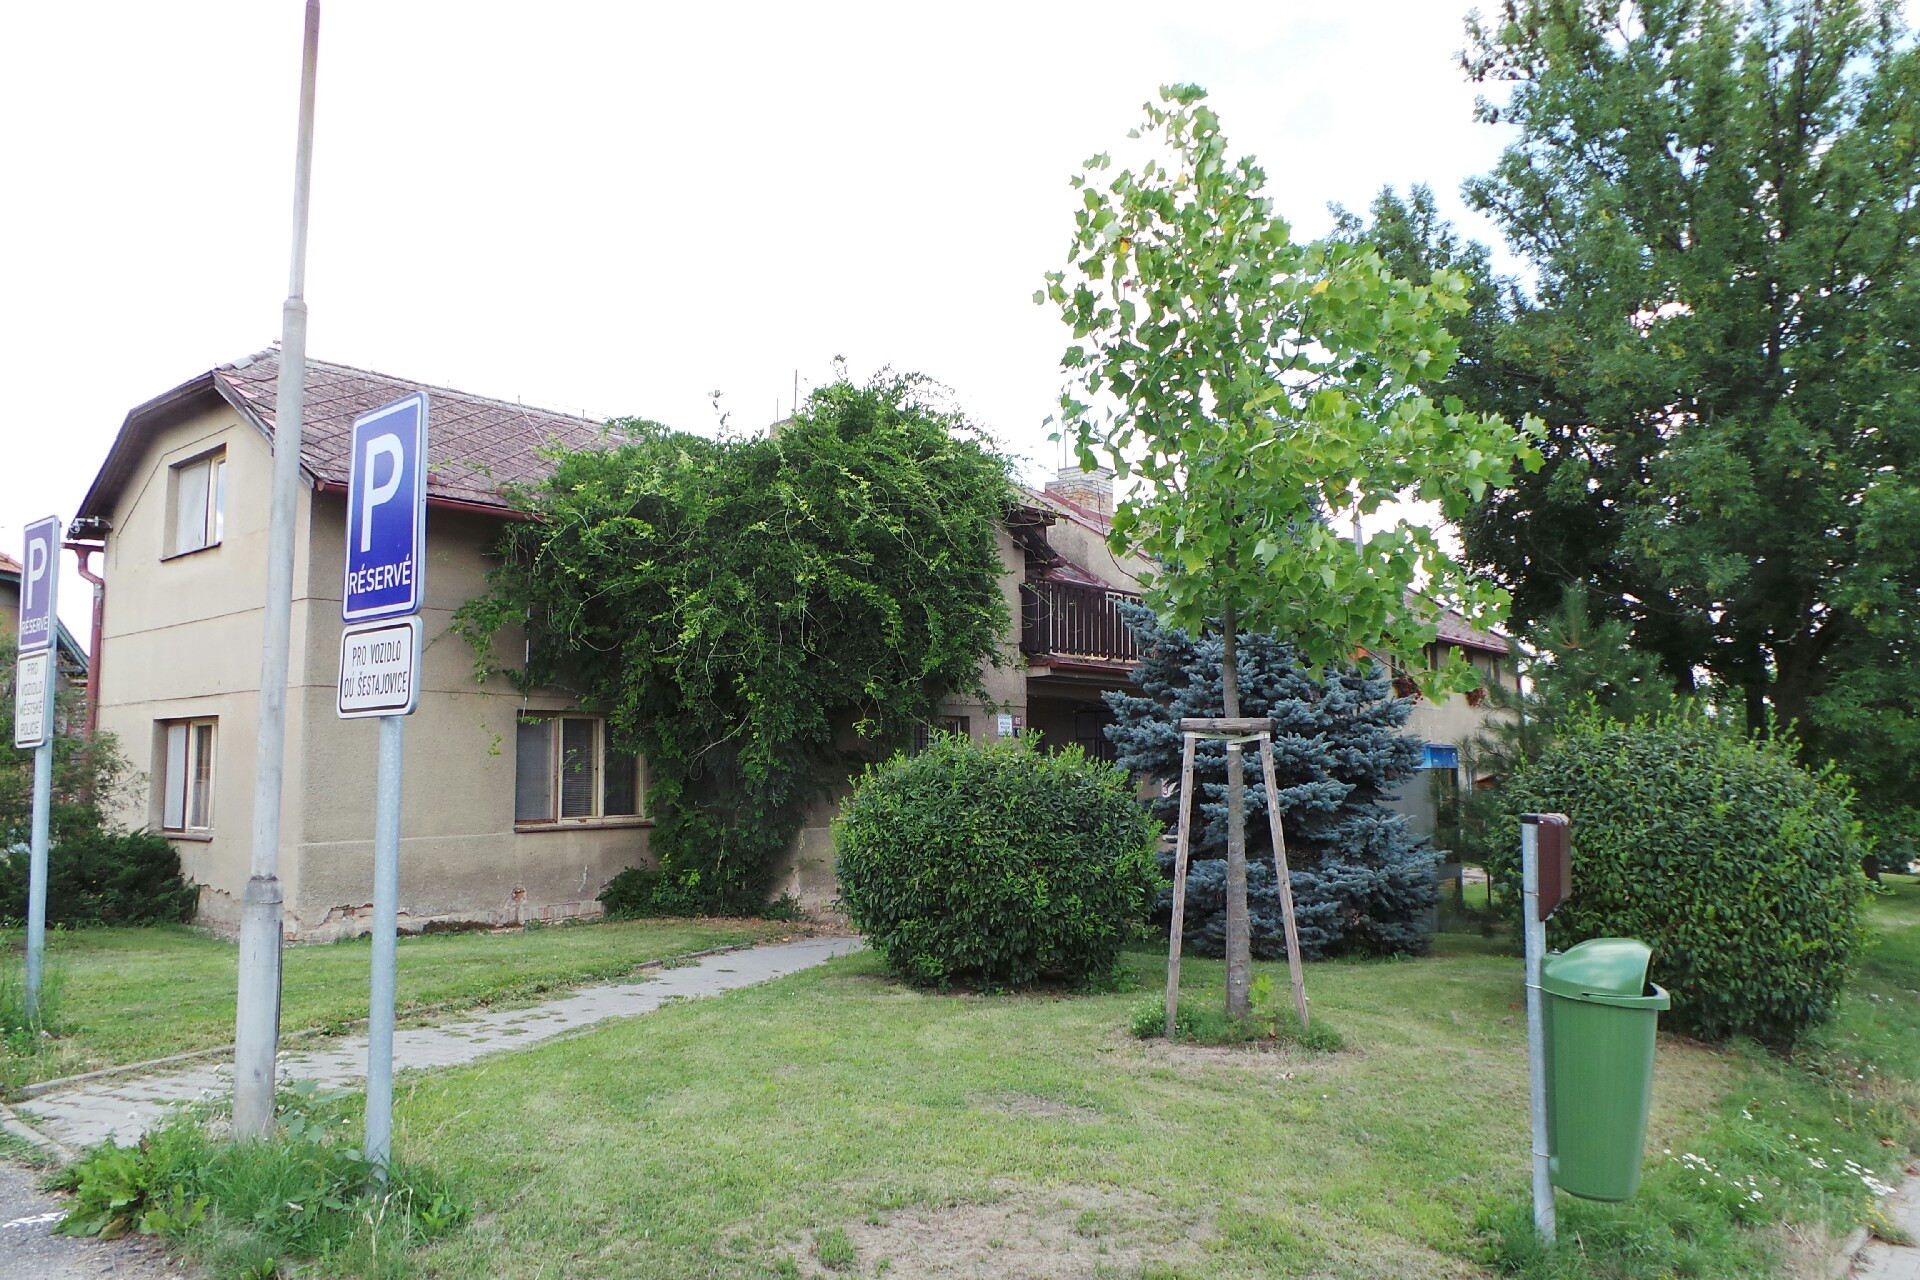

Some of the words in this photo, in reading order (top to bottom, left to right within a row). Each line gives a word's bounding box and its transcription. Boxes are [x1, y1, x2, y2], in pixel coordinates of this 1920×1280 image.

[360, 432, 404, 552] P
[26, 537, 47, 610] P
[348, 553, 411, 595] RÉSERVÉ
[352, 645, 366, 667] PRO
[371, 640, 401, 664] VOZIDLO
[344, 671, 354, 698] OÚ
[357, 671, 407, 697] ŠESTAJOVICE
